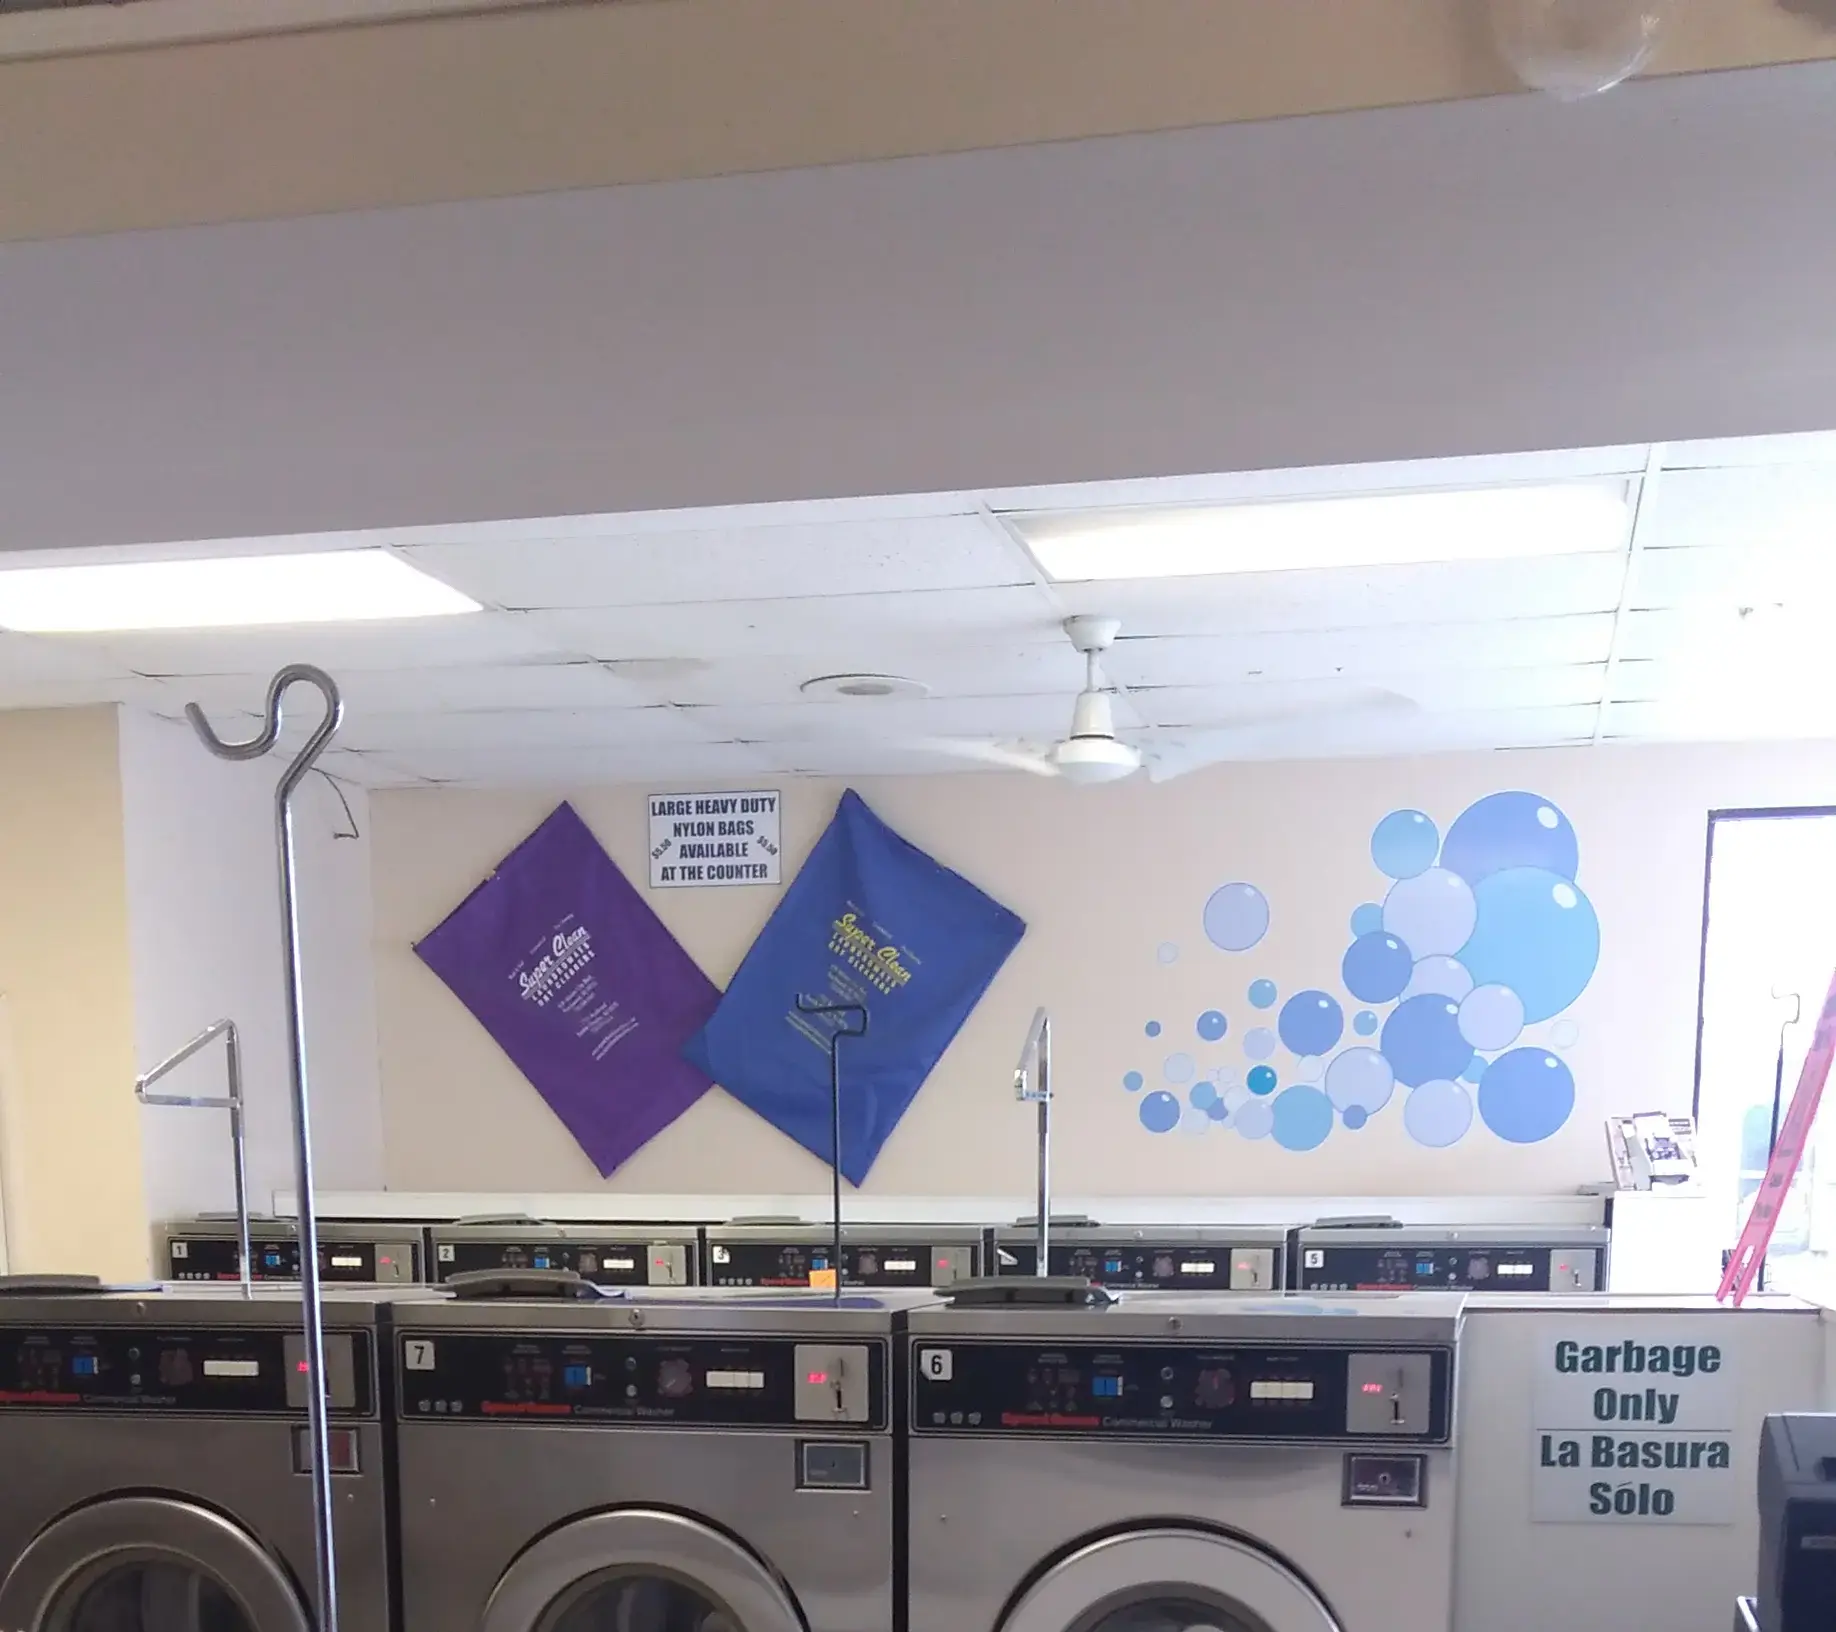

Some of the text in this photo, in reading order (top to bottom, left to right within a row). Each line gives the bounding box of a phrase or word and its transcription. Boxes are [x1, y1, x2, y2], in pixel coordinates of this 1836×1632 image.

[651, 797, 776, 816] LARGE HEAVY DUTY
[673, 820, 755, 838] NYLON BAGS
[679, 842, 748, 859] AVAILABLE
[661, 863, 768, 881] AT THE COUNTER
[834, 913, 876, 951] Super
[877, 946, 912, 982] Clean
[519, 955, 554, 996] Super
[552, 926, 587, 957] Clean
[1310, 1253, 1318, 1264] 5
[413, 1345, 425, 1365] 7
[930, 1354, 943, 1375] 6
[1555, 1340, 1721, 1377] Garbage
[1593, 1387, 1680, 1425] Only
[1170, 1416, 1213, 1430] Washer
[1540, 1435, 1730, 1469] La Basura
[1589, 1481, 1675, 1516] Sólo
